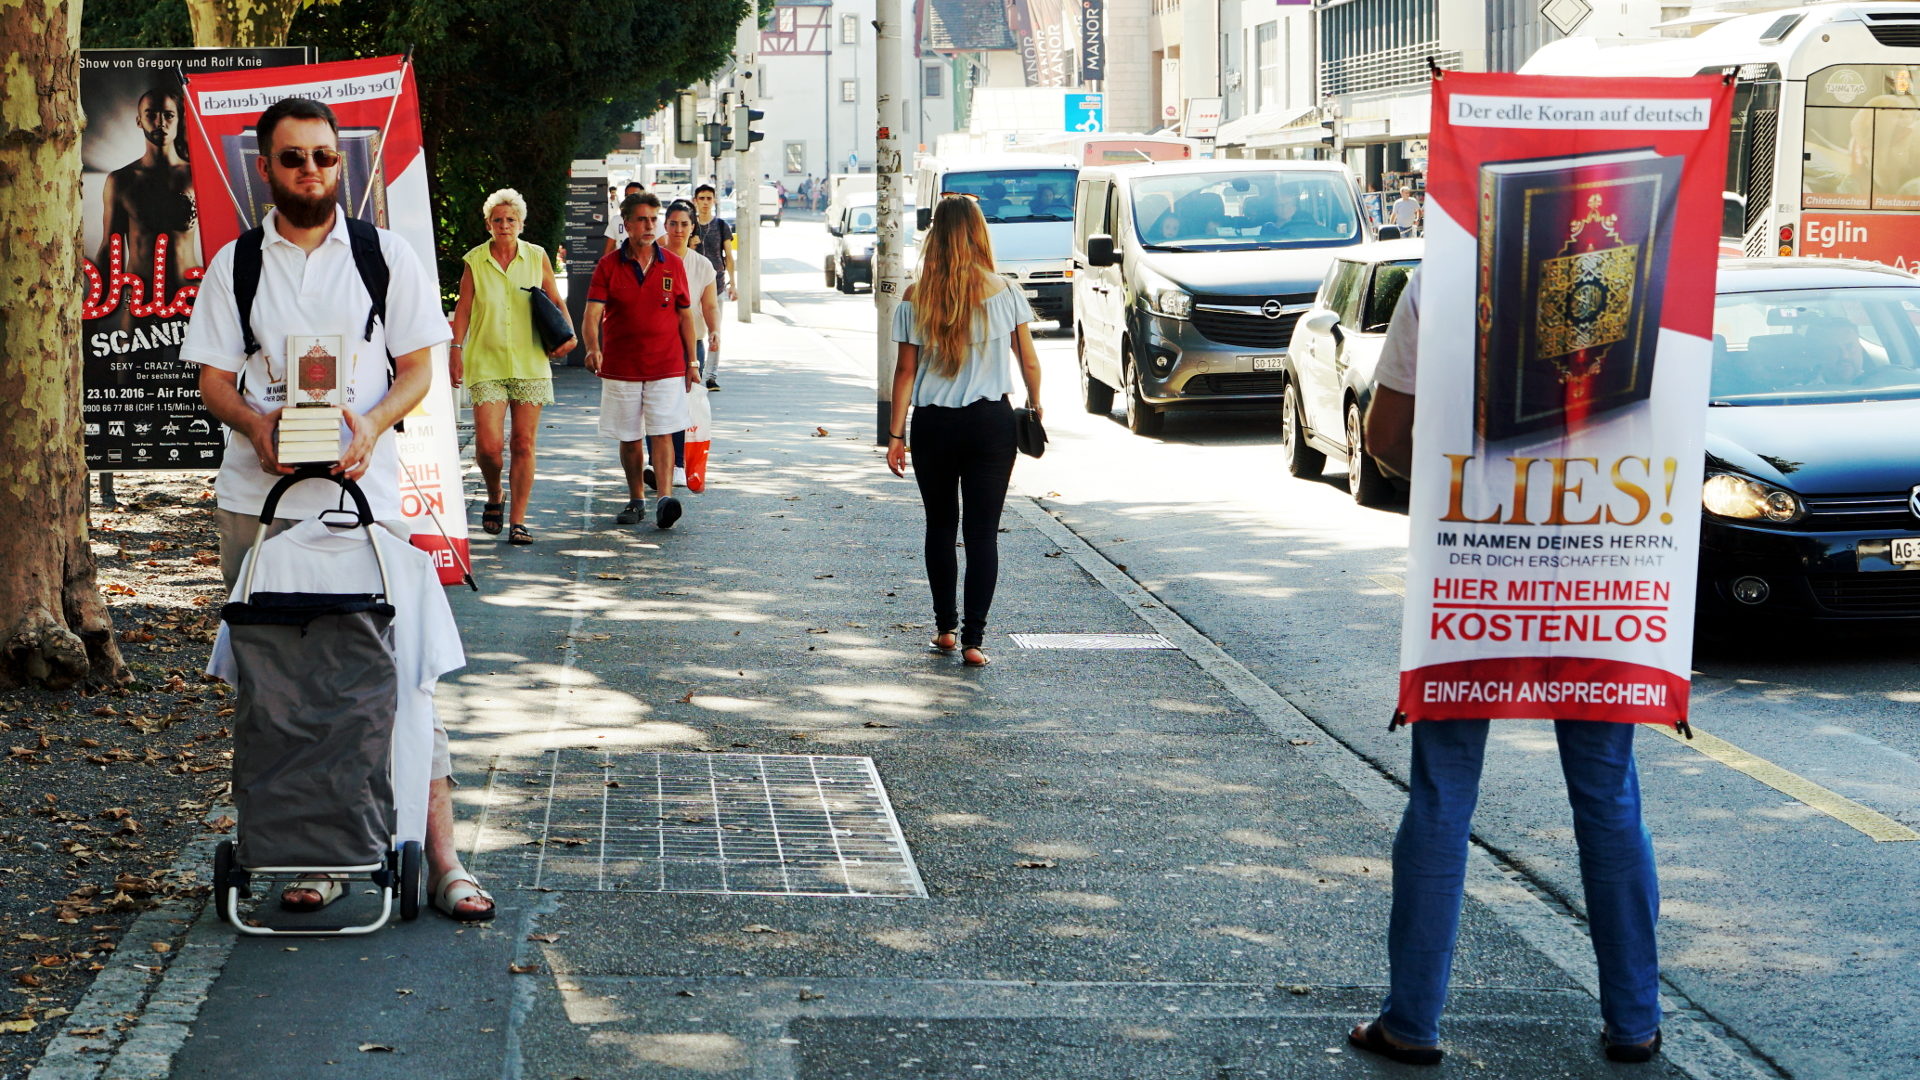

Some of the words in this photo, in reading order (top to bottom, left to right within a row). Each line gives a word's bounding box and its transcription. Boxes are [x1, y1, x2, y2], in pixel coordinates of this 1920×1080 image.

[1086, 8, 1100, 71] MANOR
[79, 57, 110, 69] Show
[113, 59, 133, 68] von
[137, 57, 182, 70] Gregory
[186, 57, 207, 67] und
[211, 56, 233, 67] Rolf
[237, 55, 263, 67] Knie
[1023, 36, 1040, 88] ANOR
[1165, 62, 1177, 72] 17
[1457, 101, 1490, 119] Der
[1496, 103, 1532, 121] edle
[1537, 105, 1594, 122] Koran
[1599, 105, 1632, 122] auf
[1633, 105, 1703, 123] deutsch
[1805, 195, 1868, 206] Chinesisches
[1805, 220, 1868, 249] Eglin
[110, 362, 134, 371] SEXY
[144, 361, 174, 370] CRAZY
[136, 372, 149, 380] Der
[151, 372, 180, 380] sechste
[181, 371, 194, 379] Akt
[87, 388, 145, 400] 23.10.2016
[157, 387, 174, 398] Air
[176, 387, 201, 398] Forc
[83, 404, 101, 412] 0900
[102, 404, 112, 412] 66
[113, 404, 123, 412] 77
[124, 403, 134, 412] 88
[135, 403, 155, 412] (CHF
[156, 402, 196, 412] 1.15/Min.)
[85, 453, 103, 461] eylor
[1437, 453, 1678, 526] LIES!
[1437, 532, 1457, 547] IM
[1463, 533, 1531, 549] NAMEN
[1537, 535, 1604, 550] DEINES
[1610, 535, 1679, 552] HERRN,
[1449, 553, 1482, 566] DER
[1486, 555, 1524, 567] DICH
[1528, 555, 1630, 568] ERSCHAFFEN
[1634, 555, 1664, 567] HAT
[1433, 577, 1498, 601] HIER
[1507, 580, 1670, 602] MITNEHMEN
[1430, 612, 1668, 643] KOSTENLOS
[1423, 681, 1513, 703] EINFACH
[1515, 681, 1668, 707] ANSPRECHEN!
